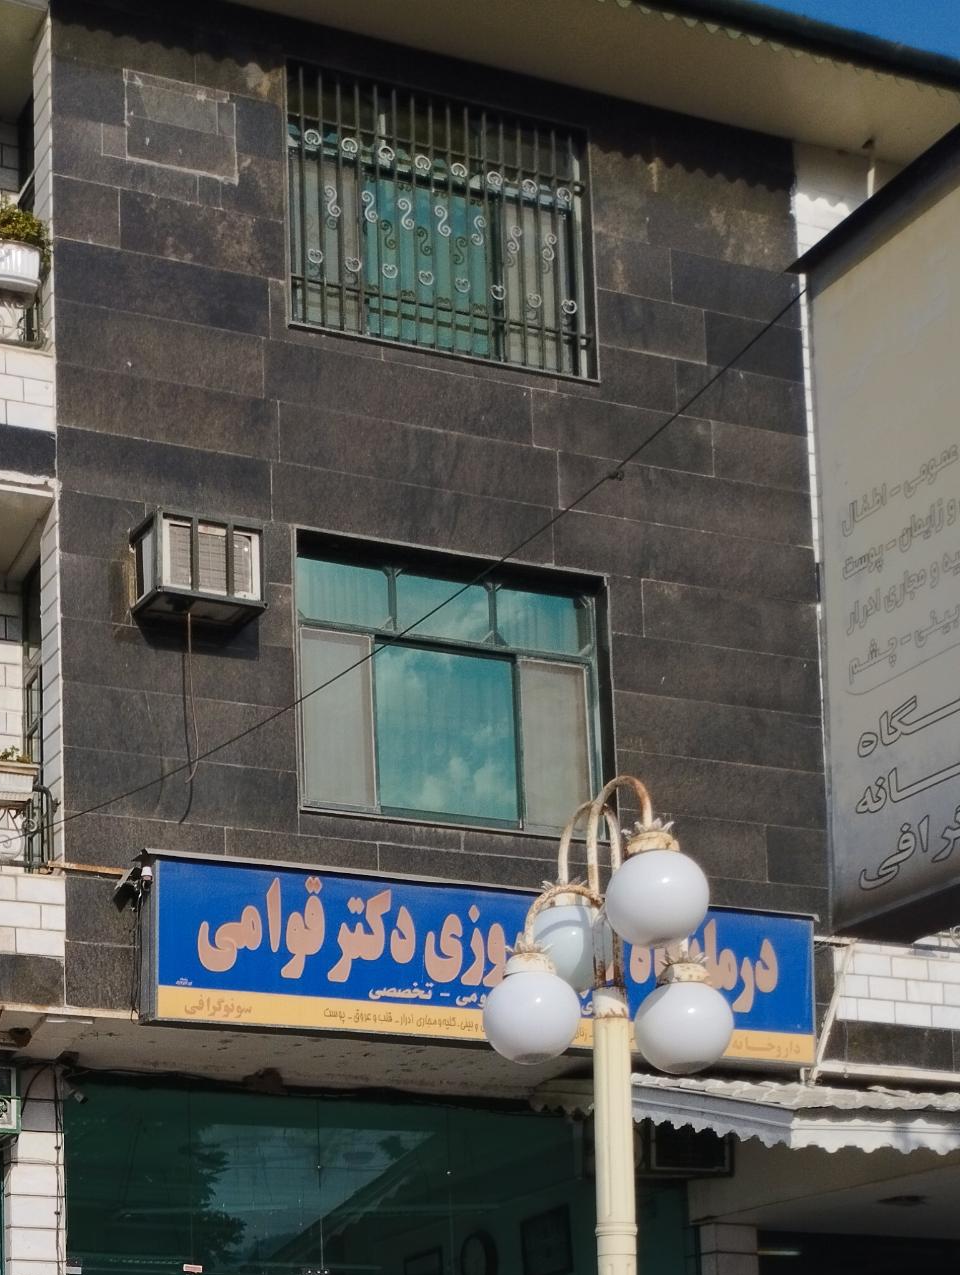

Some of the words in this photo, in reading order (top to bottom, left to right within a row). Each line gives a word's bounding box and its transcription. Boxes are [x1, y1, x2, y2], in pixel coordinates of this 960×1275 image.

[841, 482, 888, 537] اطفال
[897, 497, 945, 553] زایمان
[842, 541, 886, 581] پوست
[929, 560, 940, 589] و
[845, 586, 881, 636] ادرار
[882, 567, 929, 613] مجاری
[848, 635, 898, 684] چشم
[197, 875, 325, 979] قوامی
[327, 888, 417, 983] دکتر
[184, 993, 253, 1019] سونوگرافی
[368, 981, 434, 1001] تخصصی
[731, 1036, 801, 1058] داروخانه
